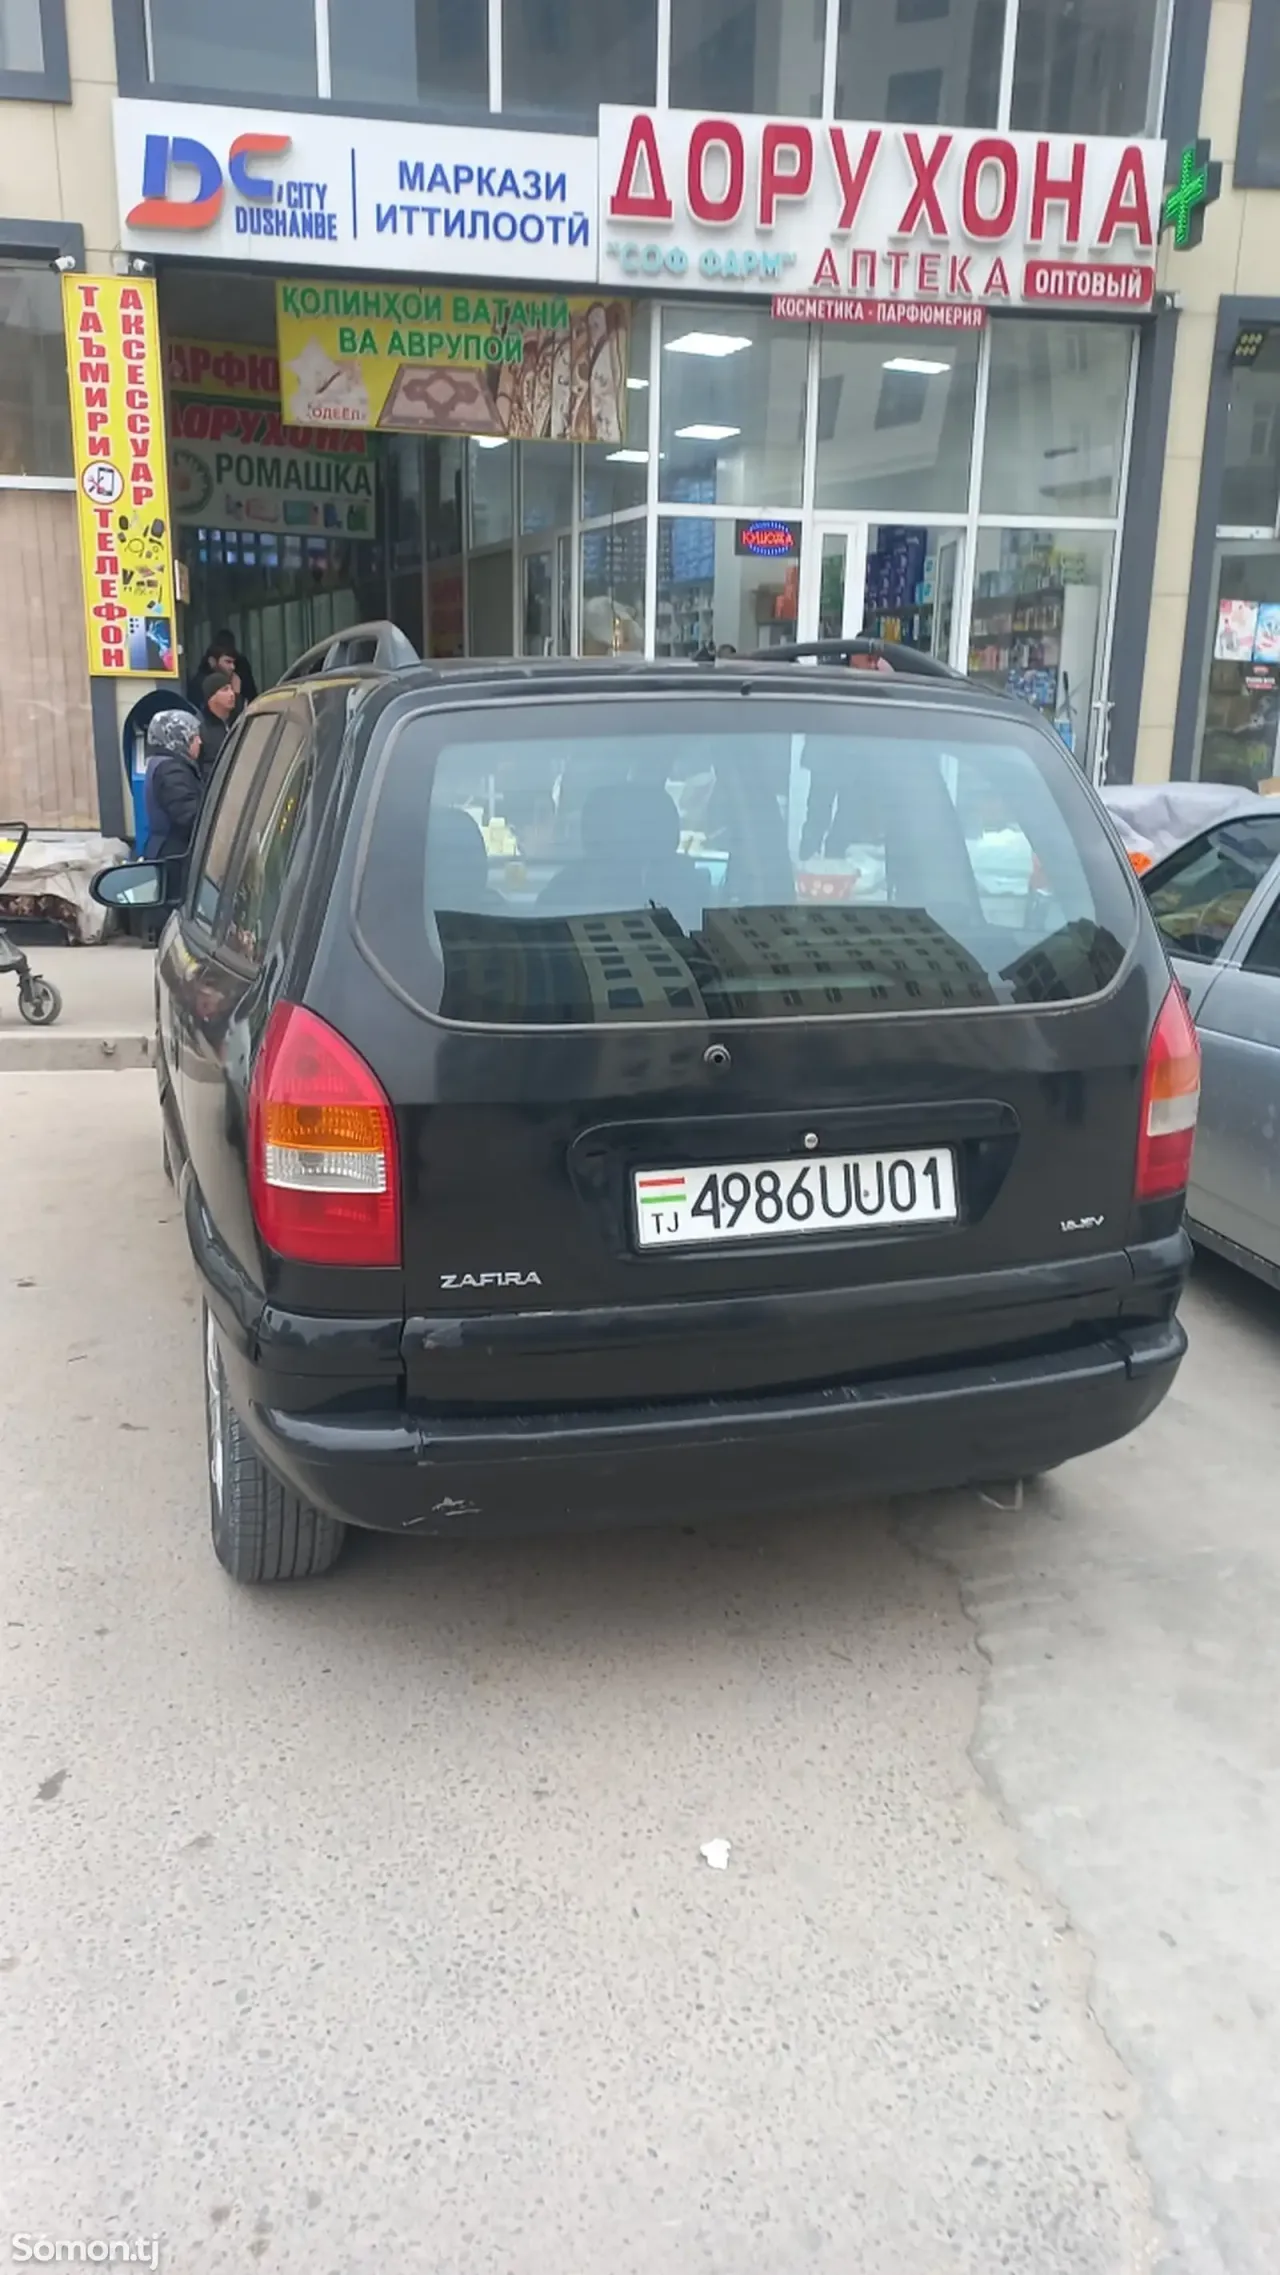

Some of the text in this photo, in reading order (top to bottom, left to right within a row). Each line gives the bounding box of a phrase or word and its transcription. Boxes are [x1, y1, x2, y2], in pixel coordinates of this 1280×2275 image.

[286, 180, 327, 210] CITY
[398, 160, 567, 203] МАРКАЗИ
[609, 114, 1153, 247] ДОРУХОНА
[235, 206, 338, 241] DUSHANBE
[813, 247, 1010, 298] АПТЕКА
[1034, 268, 1142, 299] ОПТОВЫЙ
[775, 297, 983, 327] КОСМЕТИКА ПАРФЮМЕРИЯ
[339, 326, 378, 356] ВА
[119, 287, 154, 505] АКСЕССУАР
[77, 285, 127, 668] ТАЪМИРИ ТЕЛЕФОН
[216, 452, 372, 496] РОМАШКА
[690, 1157, 942, 1230] 4986UU01
[651, 1211, 680, 1235] TJ
[440, 1271, 542, 1289] ZAFIRA
